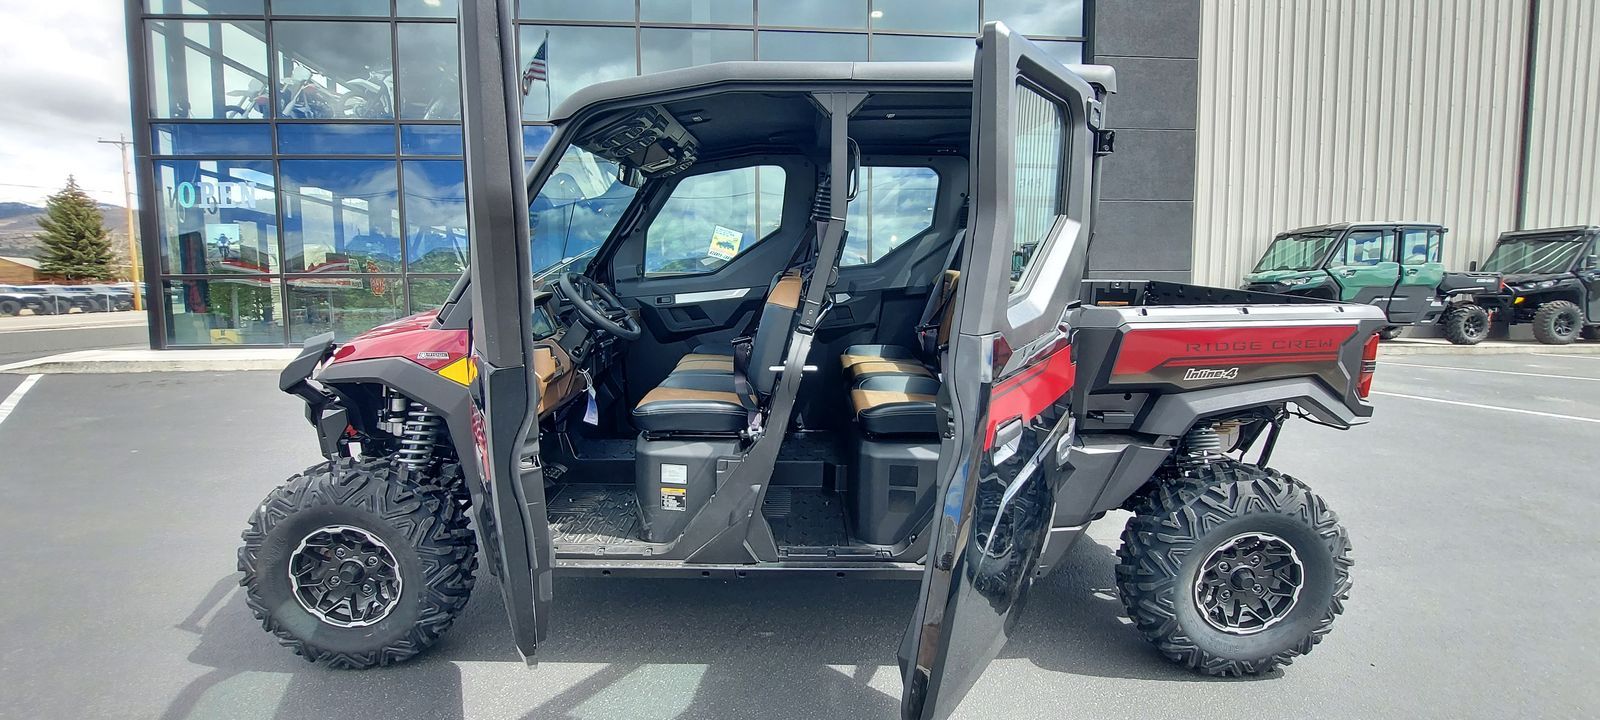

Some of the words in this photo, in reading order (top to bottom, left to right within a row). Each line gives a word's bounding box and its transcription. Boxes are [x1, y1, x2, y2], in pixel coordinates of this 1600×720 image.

[178, 181, 256, 208] OPEN
[1186, 341, 1262, 352] RIDGE
[1272, 339, 1332, 350] CREW
[1183, 367, 1239, 381] Inline-4
